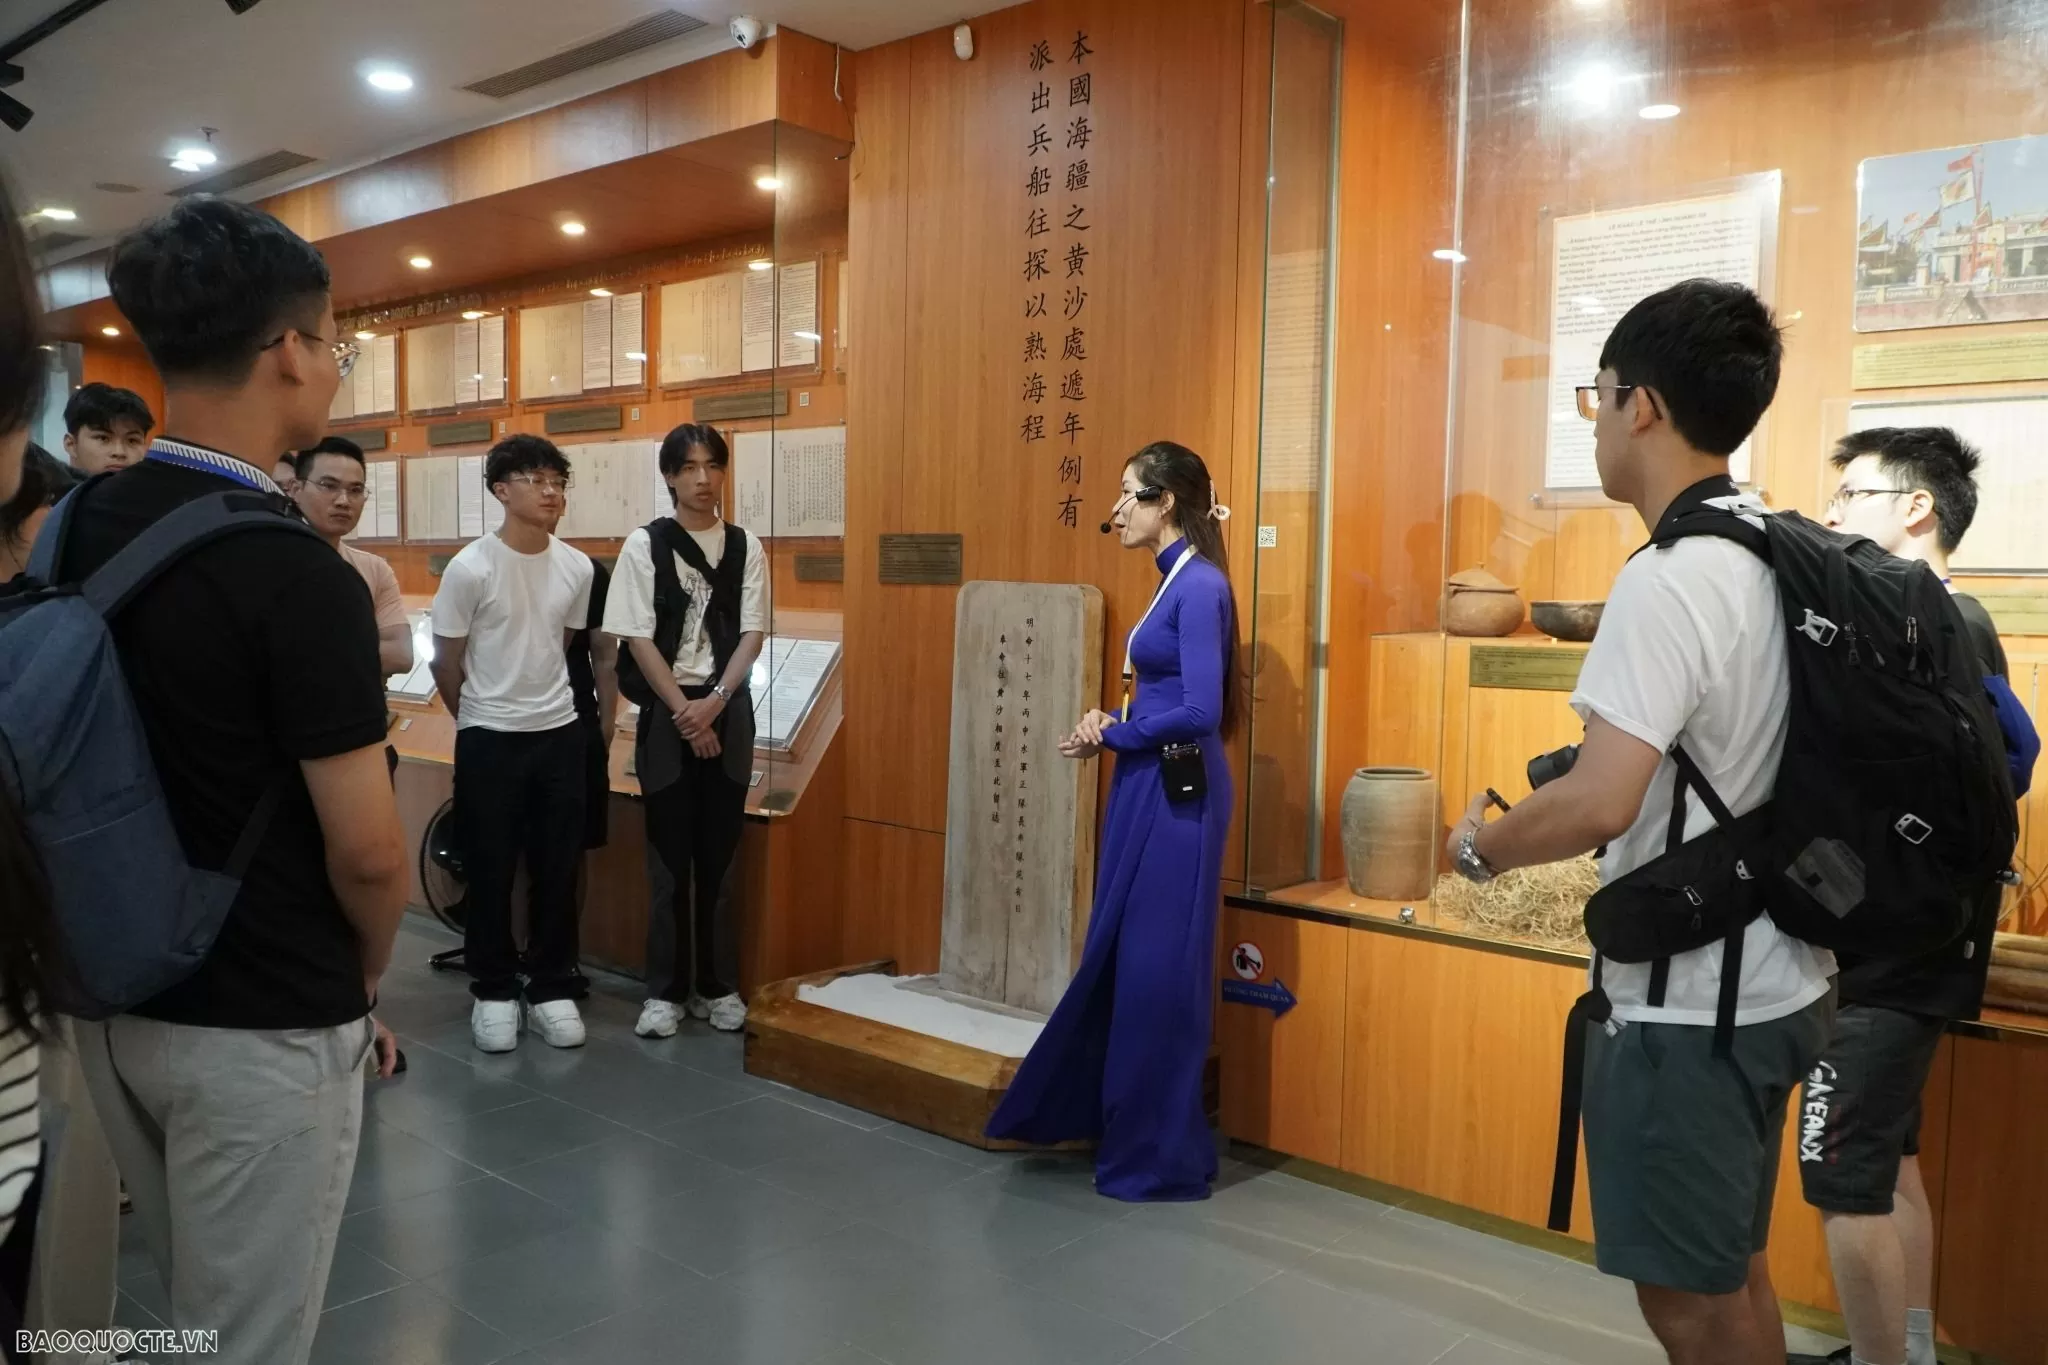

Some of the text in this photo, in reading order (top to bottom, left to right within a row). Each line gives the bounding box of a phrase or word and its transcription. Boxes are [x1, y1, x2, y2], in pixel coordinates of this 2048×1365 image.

[1020, 41, 1055, 444] 派出兵船往探以熟海程
